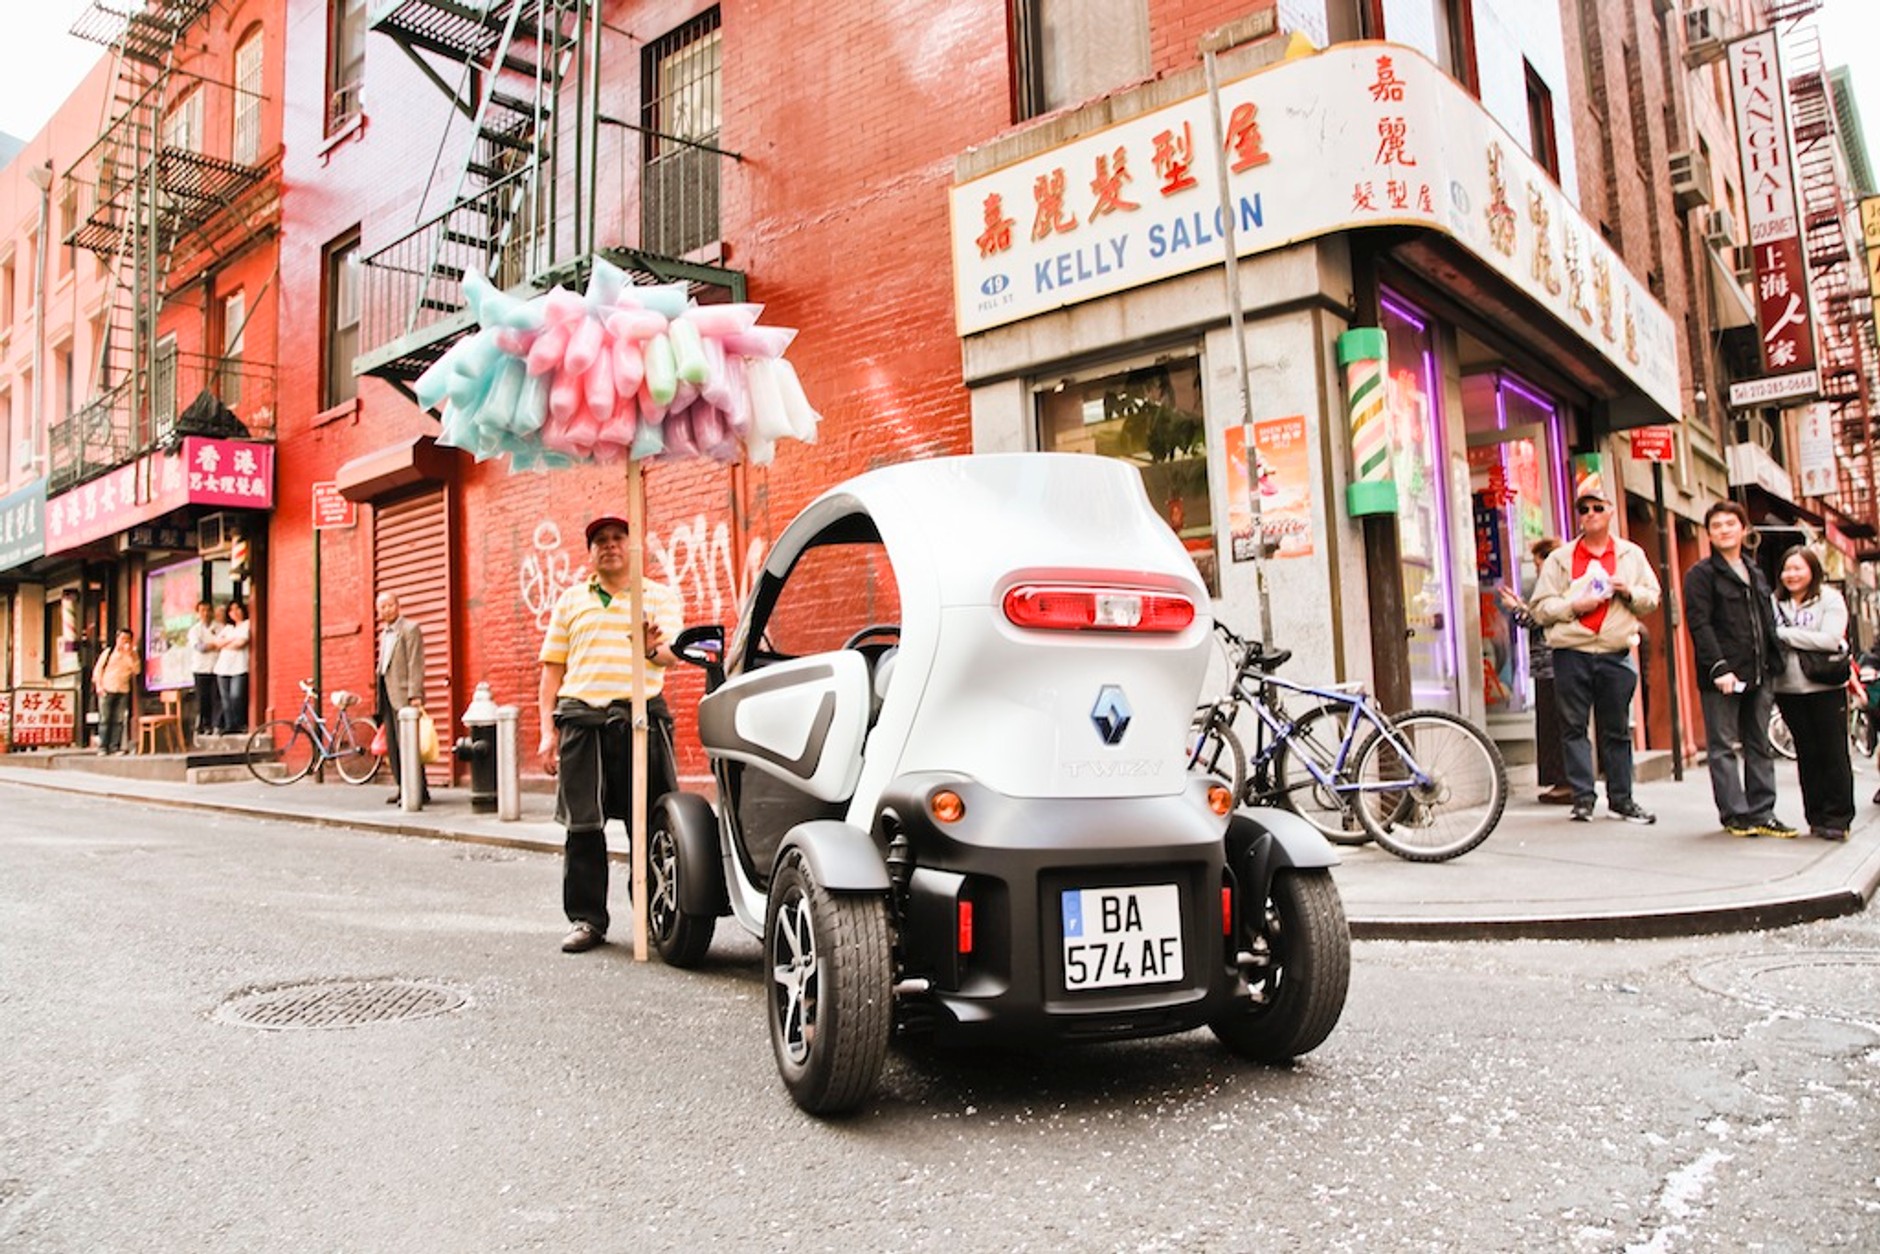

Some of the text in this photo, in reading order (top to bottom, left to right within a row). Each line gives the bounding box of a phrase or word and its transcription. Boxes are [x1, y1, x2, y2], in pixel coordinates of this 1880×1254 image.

[1368, 54, 1417, 166] 嘉麗
[1741, 41, 1782, 213] SHANGHAI
[974, 102, 1272, 259] 嘉麗髮型屋
[1351, 180, 1434, 213] 髮型屋
[1034, 192, 1264, 295] KELLY SALON
[1752, 216, 1795, 240] GOURMET
[1759, 244, 1807, 368] 上海人家
[194, 444, 258, 476] 香港
[1061, 759, 1164, 778] TWIZY
[1069, 918, 1078, 931] F
[1101, 894, 1143, 934] BA
[1067, 937, 1178, 984] 574 AF
